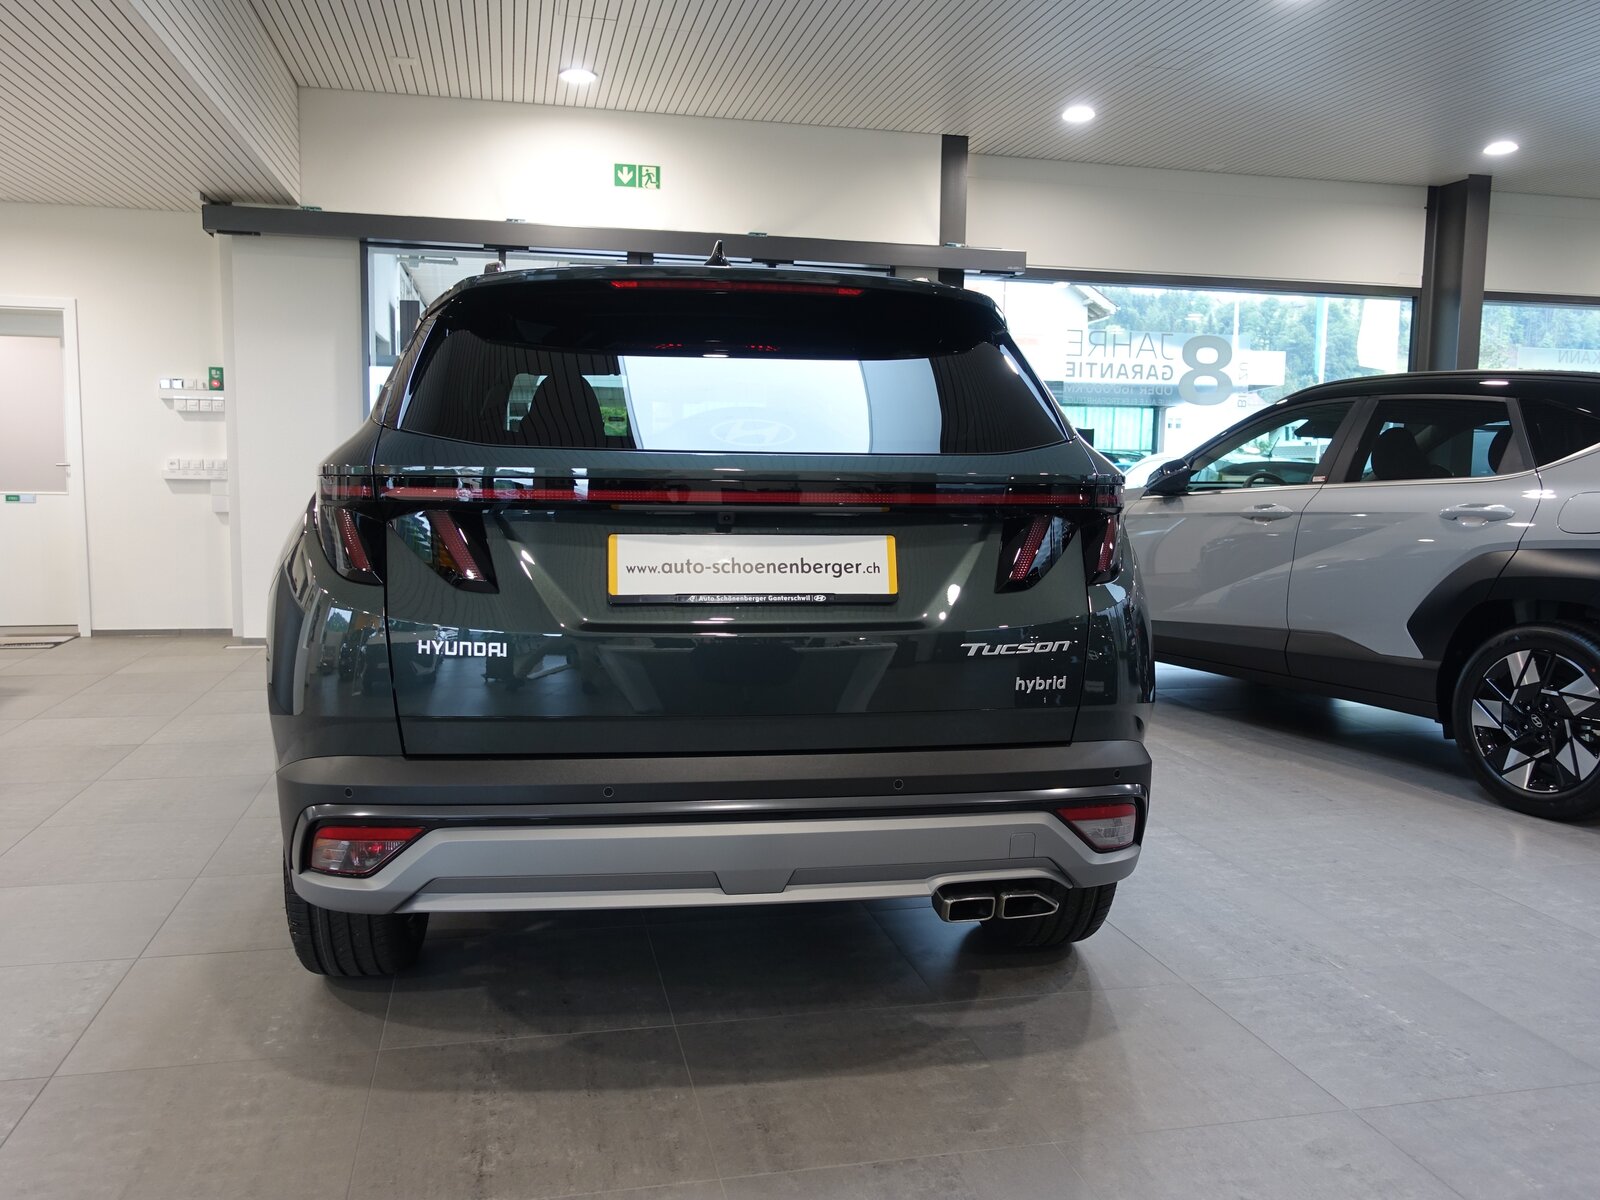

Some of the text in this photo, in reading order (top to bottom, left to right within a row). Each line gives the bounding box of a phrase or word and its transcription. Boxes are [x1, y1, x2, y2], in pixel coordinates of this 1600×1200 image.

[626, 557, 881, 578] www.auto-schoenenberger.ch
[417, 640, 508, 658] HYUNDAI
[1015, 675, 1067, 694] hybrid
